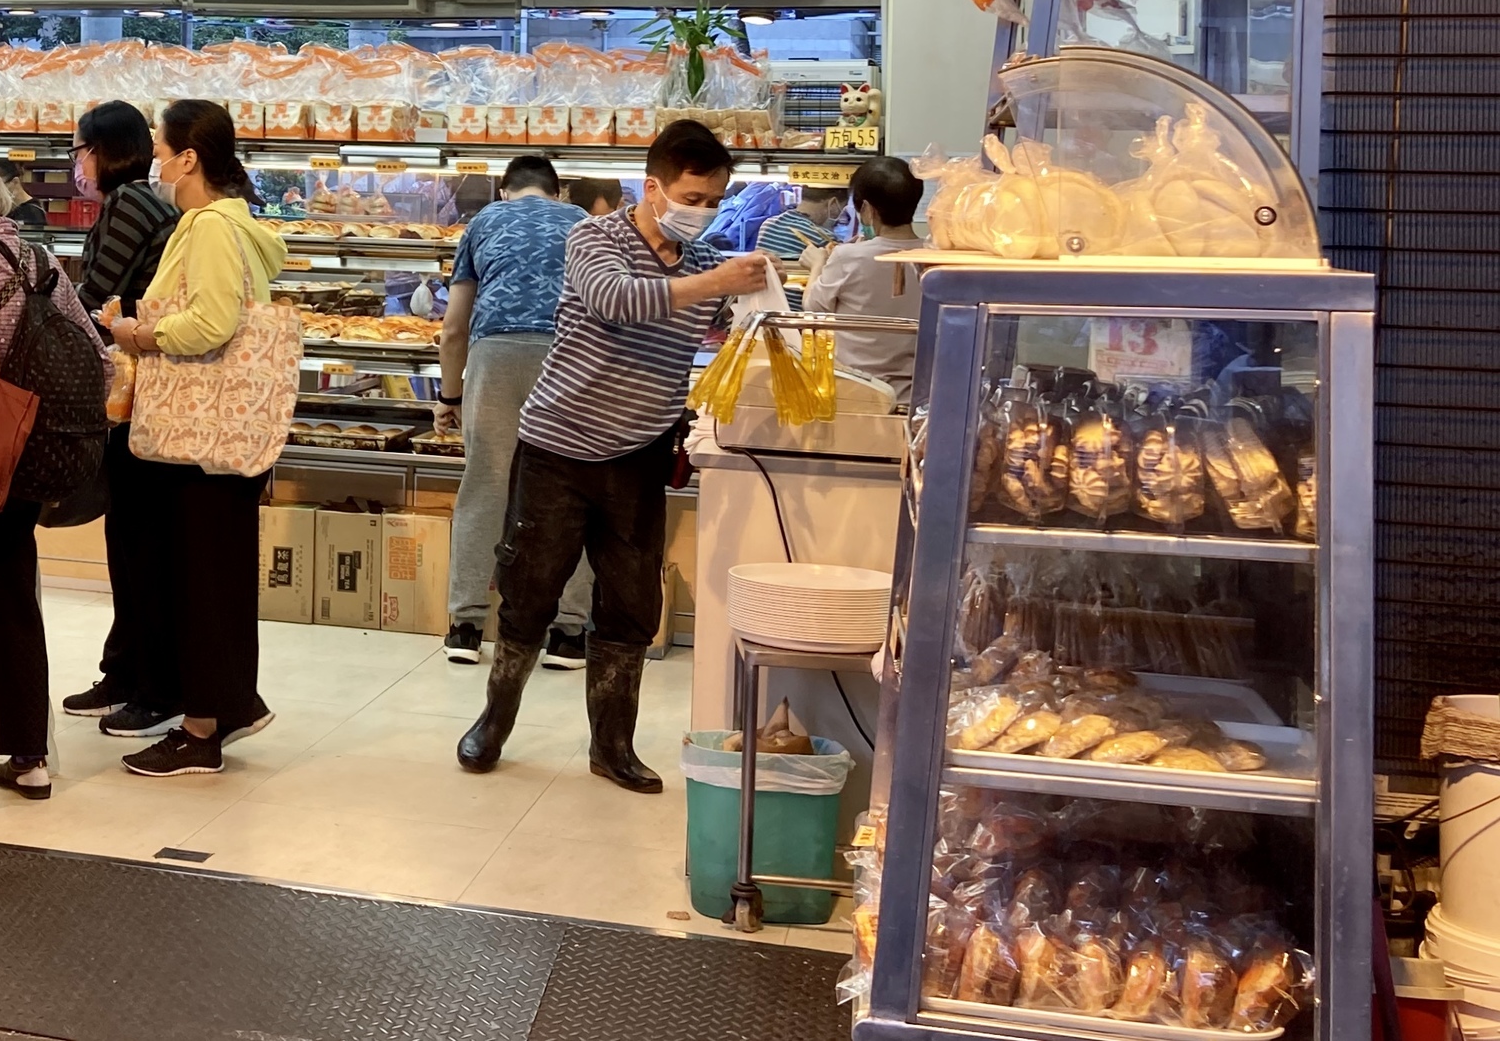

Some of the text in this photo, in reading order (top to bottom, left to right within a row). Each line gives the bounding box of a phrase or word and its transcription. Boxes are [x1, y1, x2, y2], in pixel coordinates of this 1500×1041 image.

[830, 129, 875, 148] 方包 5.5
[792, 171, 840, 180] 各式三文治
